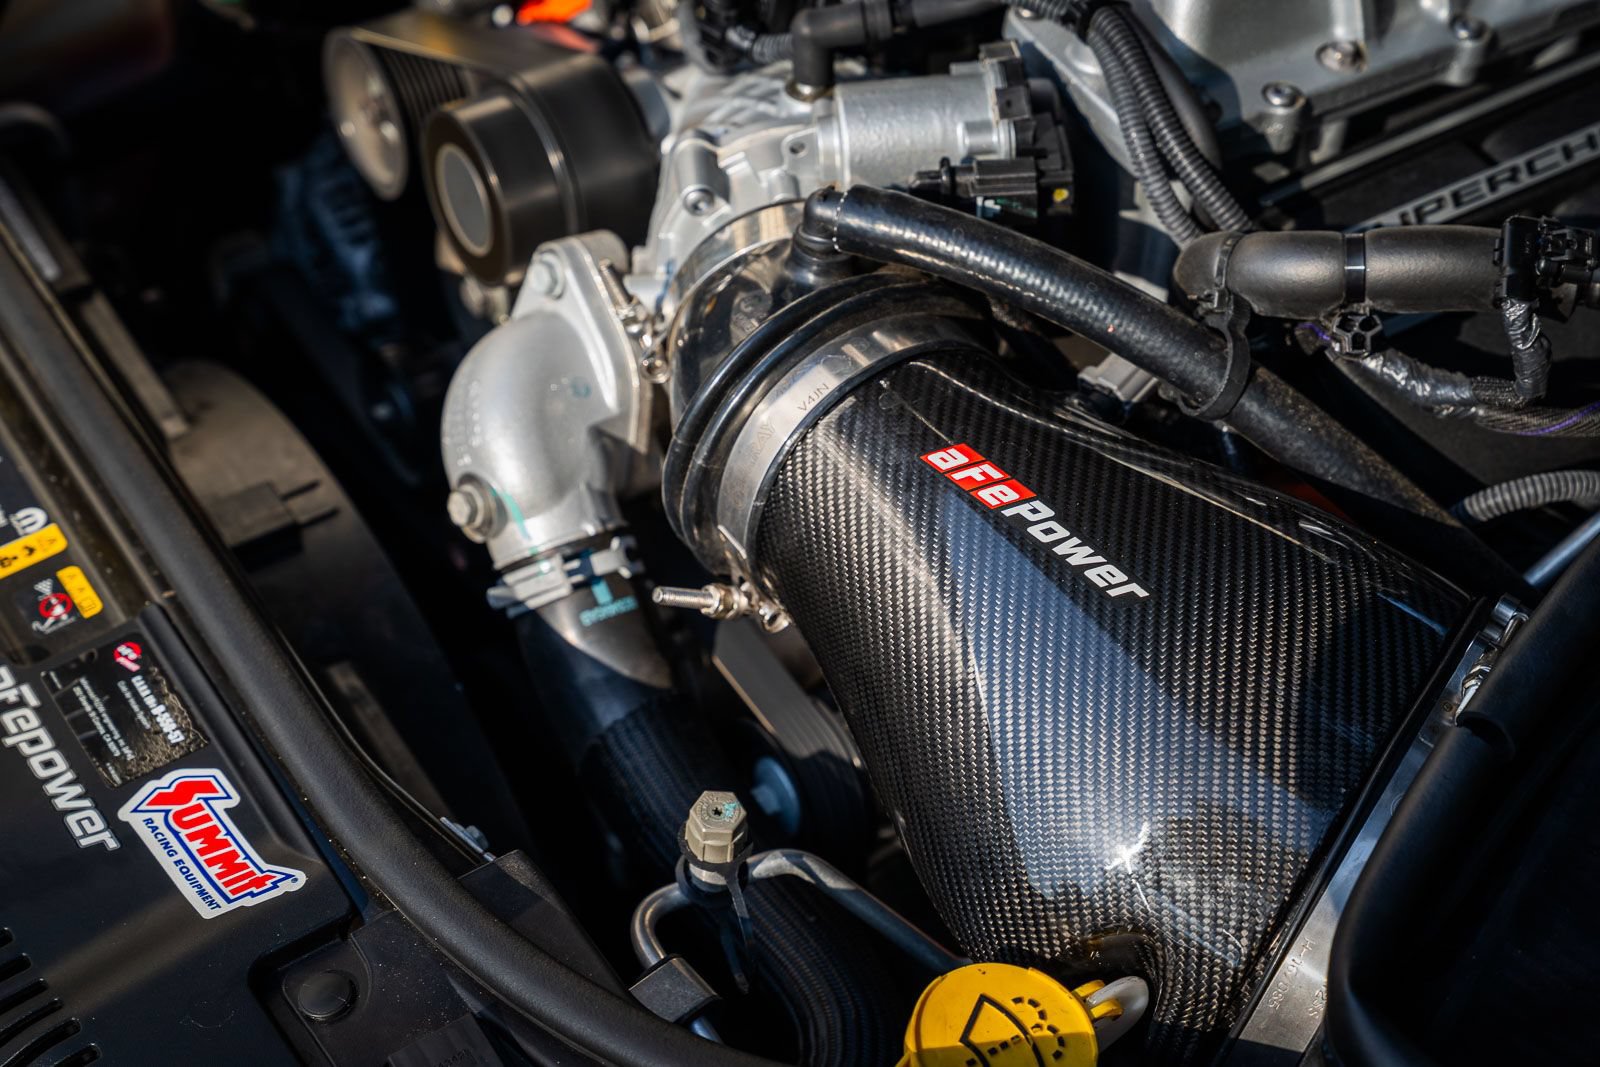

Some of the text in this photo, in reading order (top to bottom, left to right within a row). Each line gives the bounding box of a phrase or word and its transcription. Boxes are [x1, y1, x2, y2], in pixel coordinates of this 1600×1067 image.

[1372, 126, 1600, 226] PERCH
[142, 817, 222, 911] RACING EQUIPMENT
